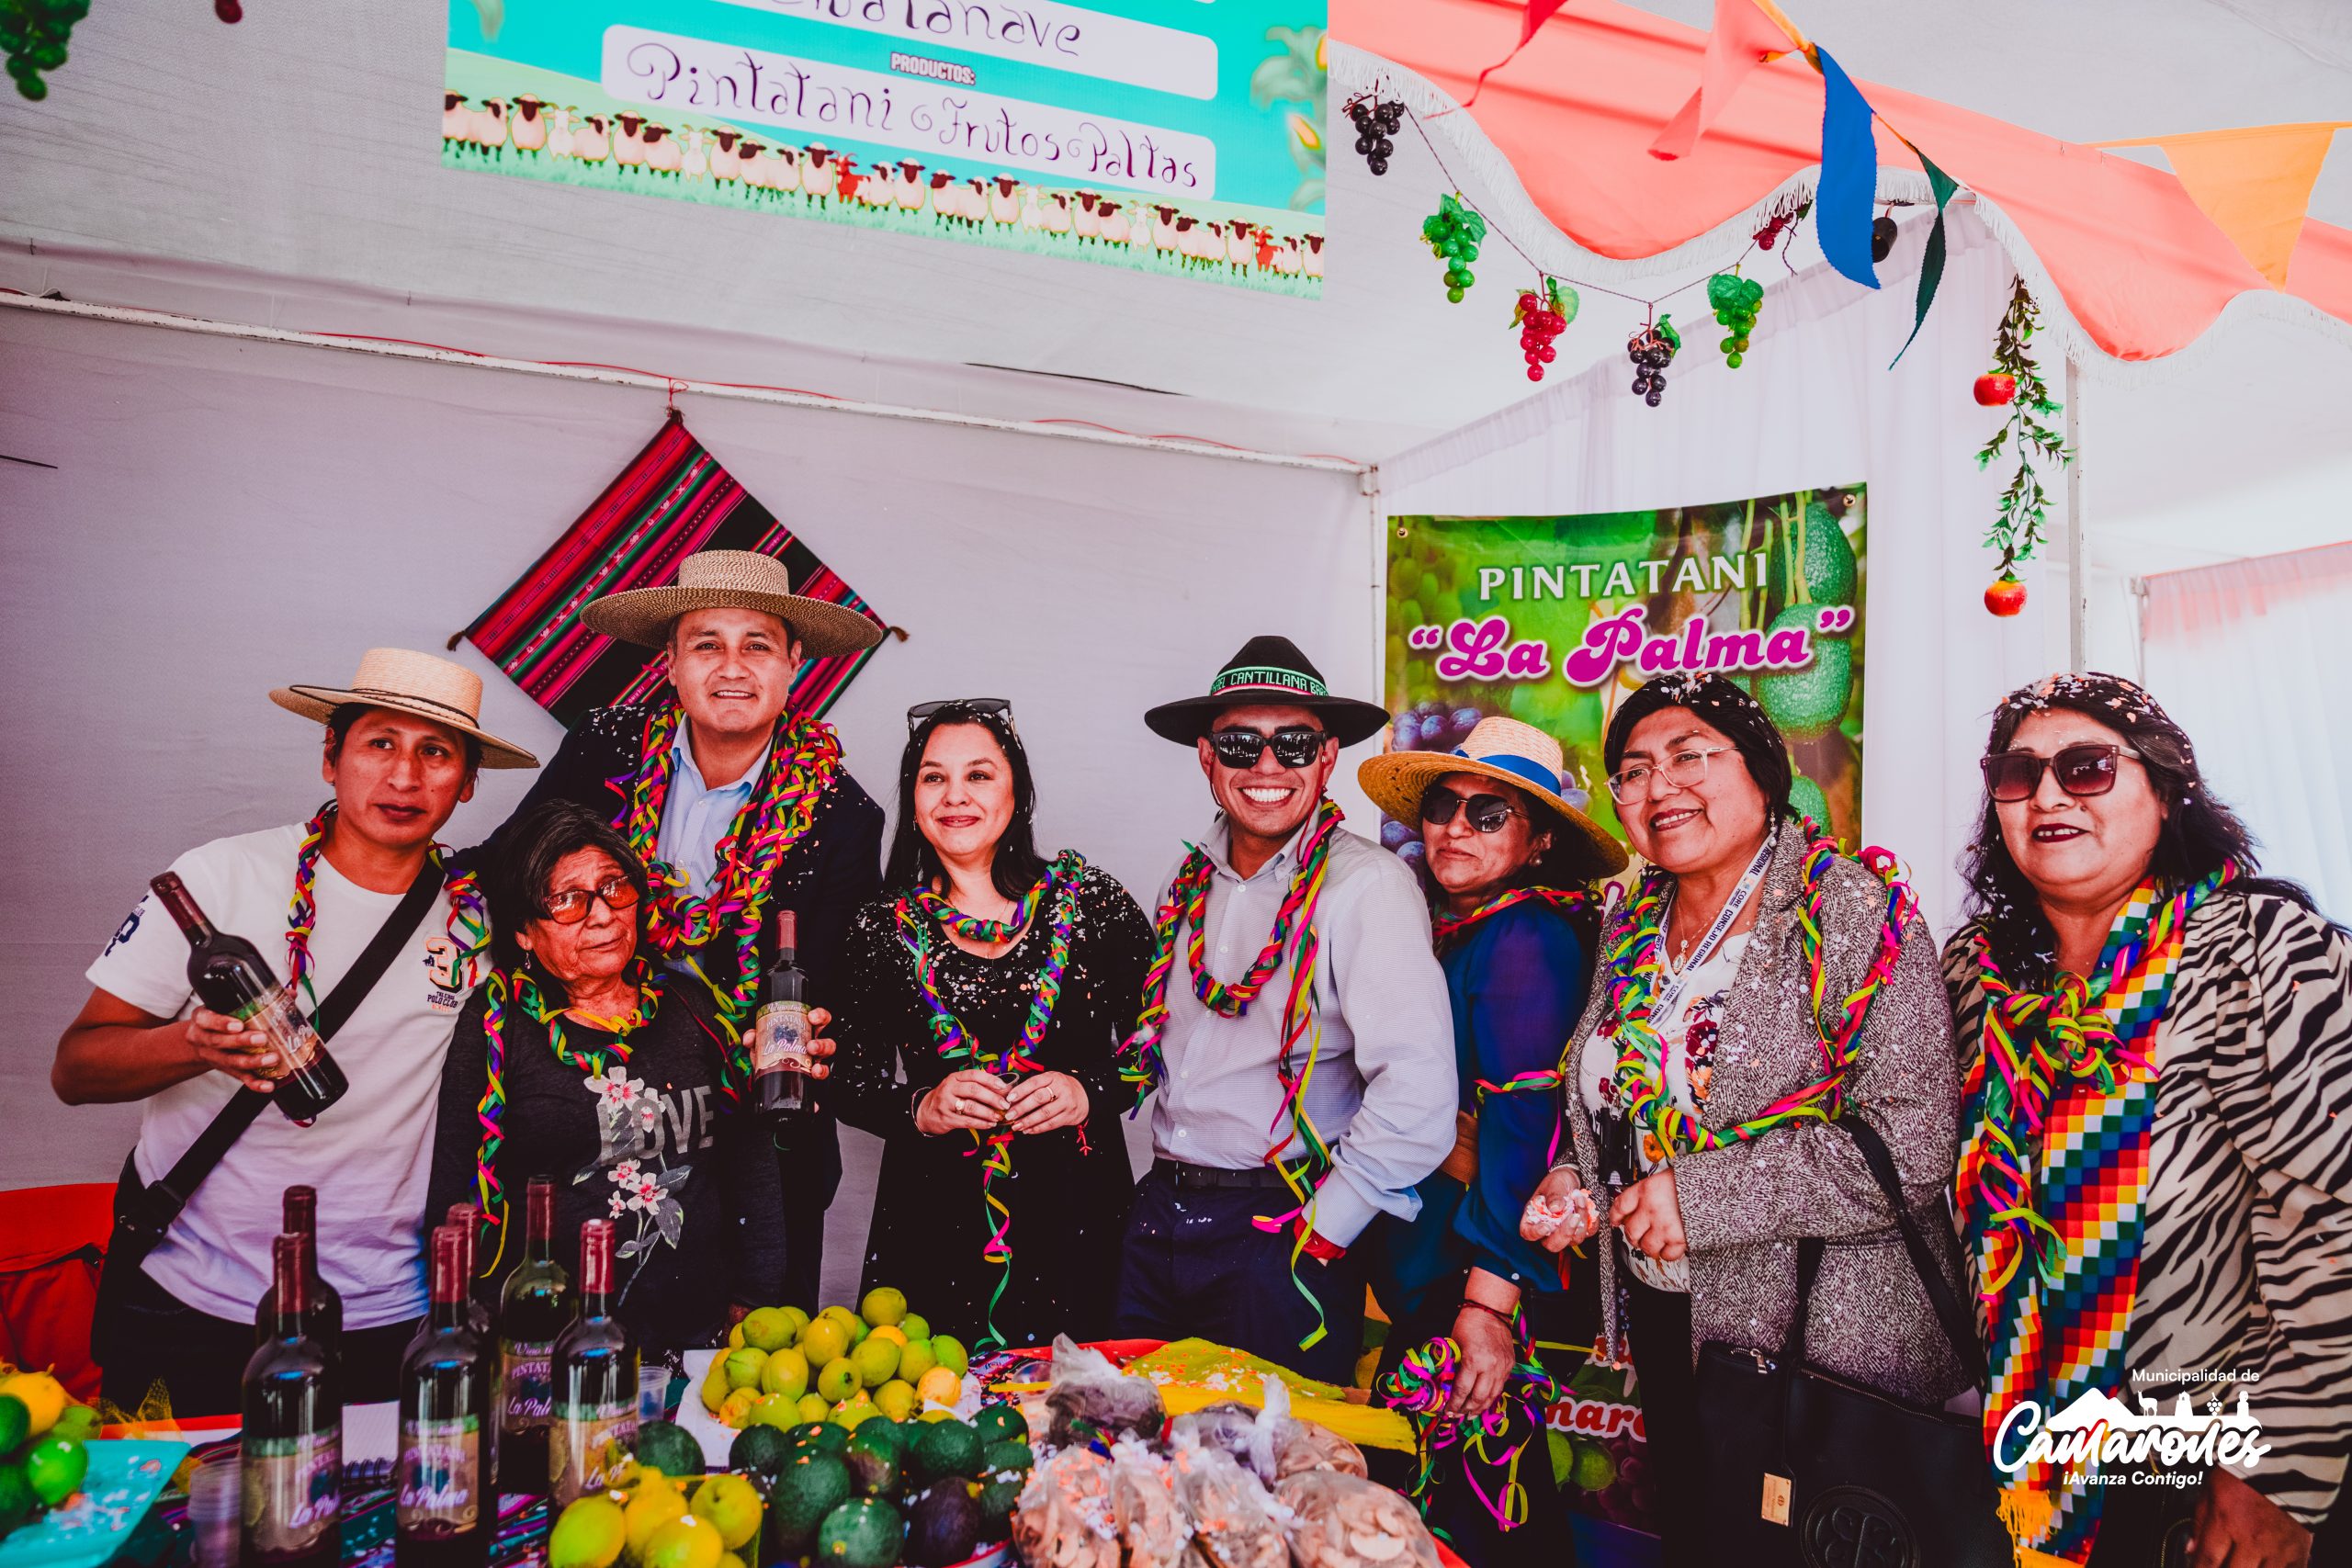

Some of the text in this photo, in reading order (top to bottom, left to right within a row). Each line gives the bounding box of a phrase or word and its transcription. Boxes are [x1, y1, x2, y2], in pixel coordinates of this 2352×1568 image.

[890, 51, 977, 85] PRODUCTOS:
[628, 42, 1196, 187] Pintatani Frutos Paltas
[1479, 552, 1767, 601] PINTATANI
[1231, 671, 1307, 691] CANTILLANA
[1686, 908, 1734, 972] CONSEJO REGIONAL
[427, 994, 443, 1005] POLO
[763, 1037, 807, 1055] La Palma
[596, 1085, 714, 1168] LOVE
[507, 1396, 522, 1415] La
